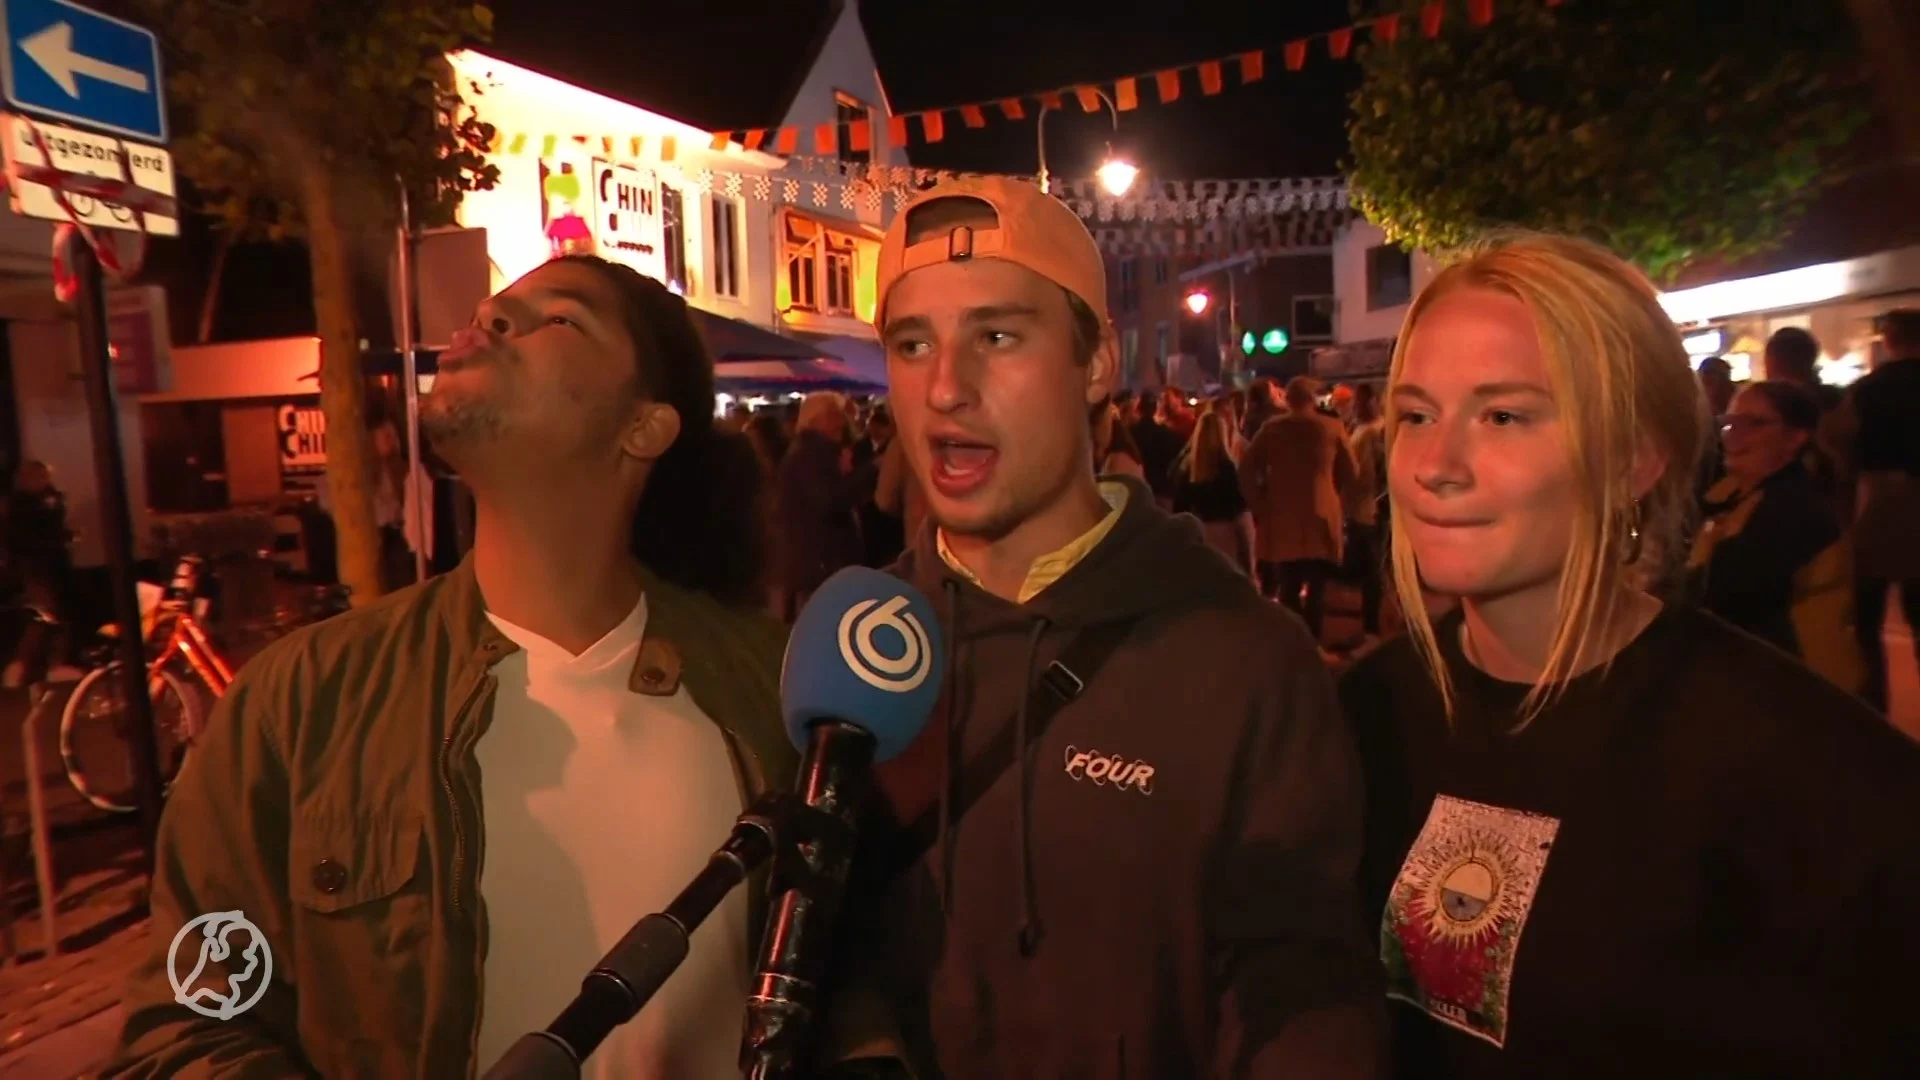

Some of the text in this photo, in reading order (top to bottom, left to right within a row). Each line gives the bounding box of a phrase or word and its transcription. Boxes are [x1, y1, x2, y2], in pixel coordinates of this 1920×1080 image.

[20, 129, 165, 173] utgezonerd
[838, 595, 932, 692] 6
[1065, 751, 1155, 787] FOUR
